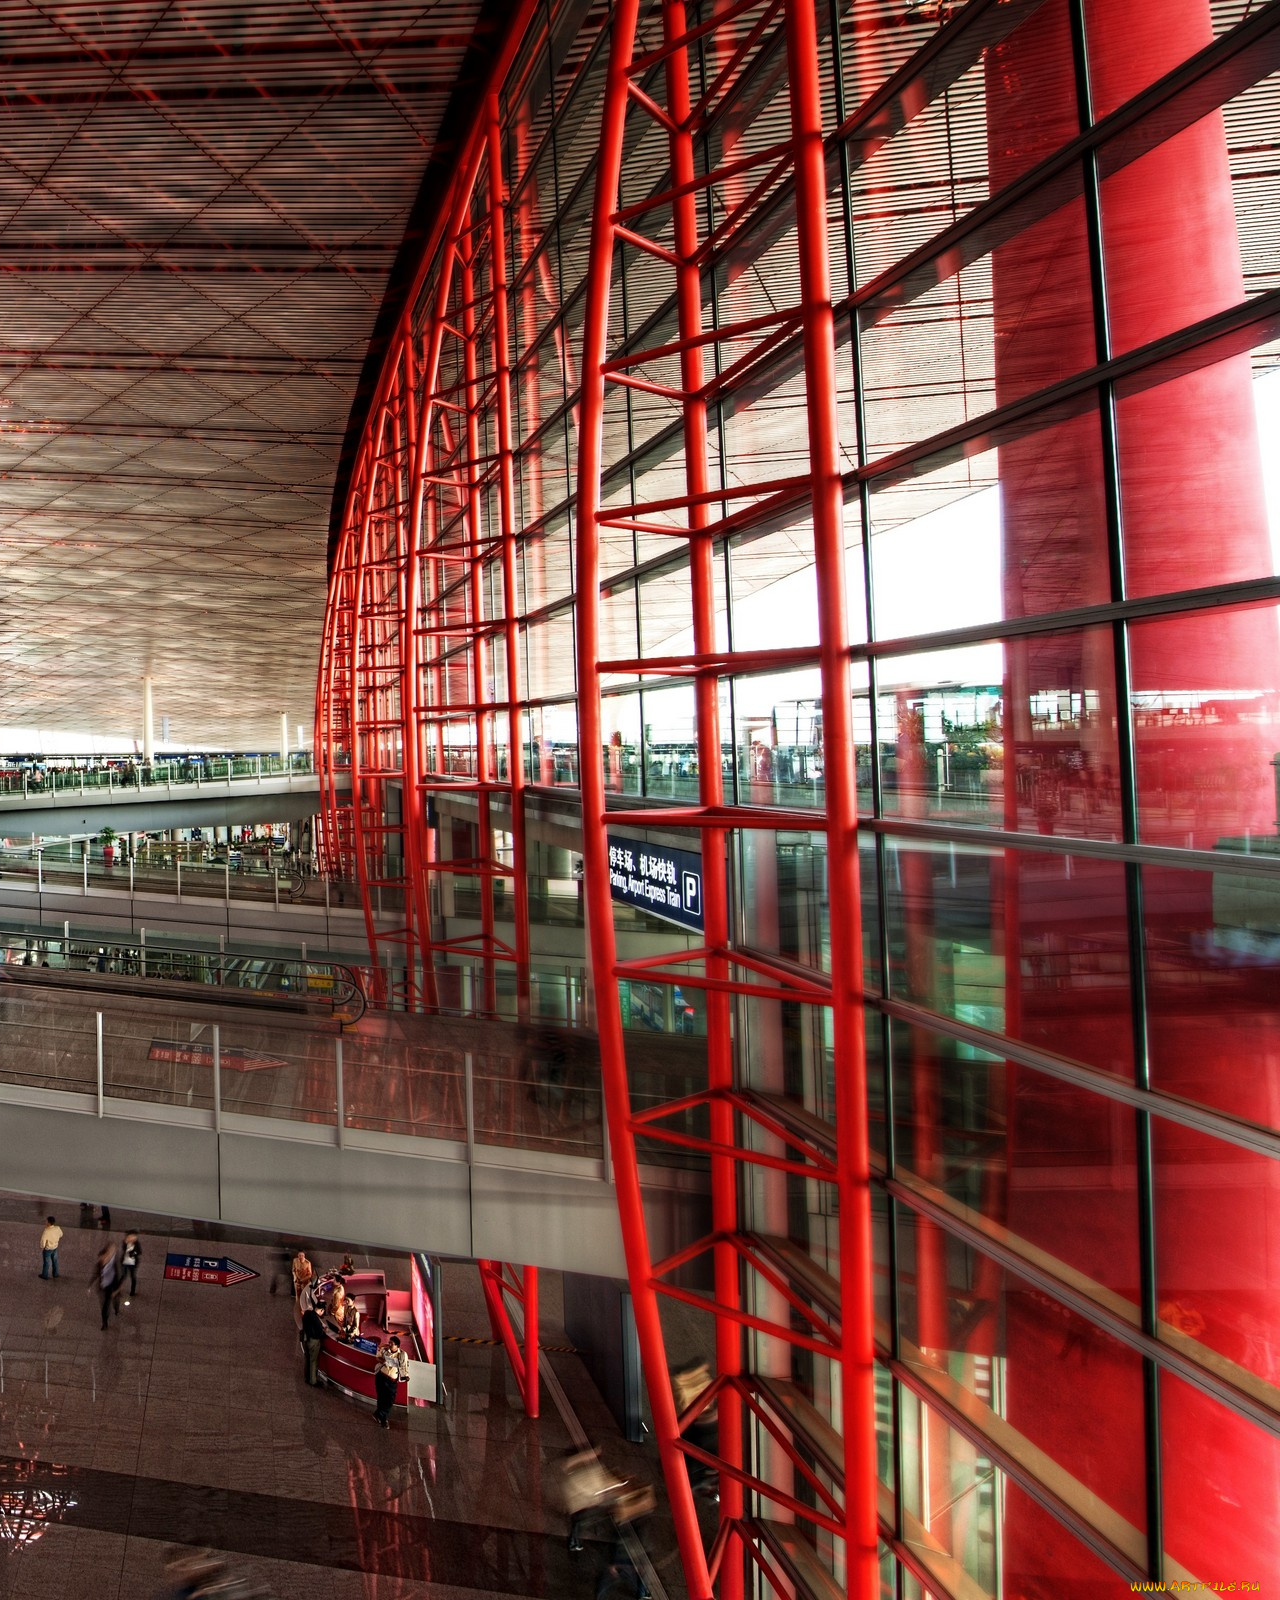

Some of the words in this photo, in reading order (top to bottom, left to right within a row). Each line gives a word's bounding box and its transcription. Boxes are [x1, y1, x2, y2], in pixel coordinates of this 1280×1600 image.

[609, 846, 677, 884] 停车场、机场快轨
[610, 868, 628, 893] Parking,
[628, 874, 645, 897] Airport
[645, 880, 666, 903] Express
[666, 886, 681, 908] Train
[685, 876, 696, 907] P
